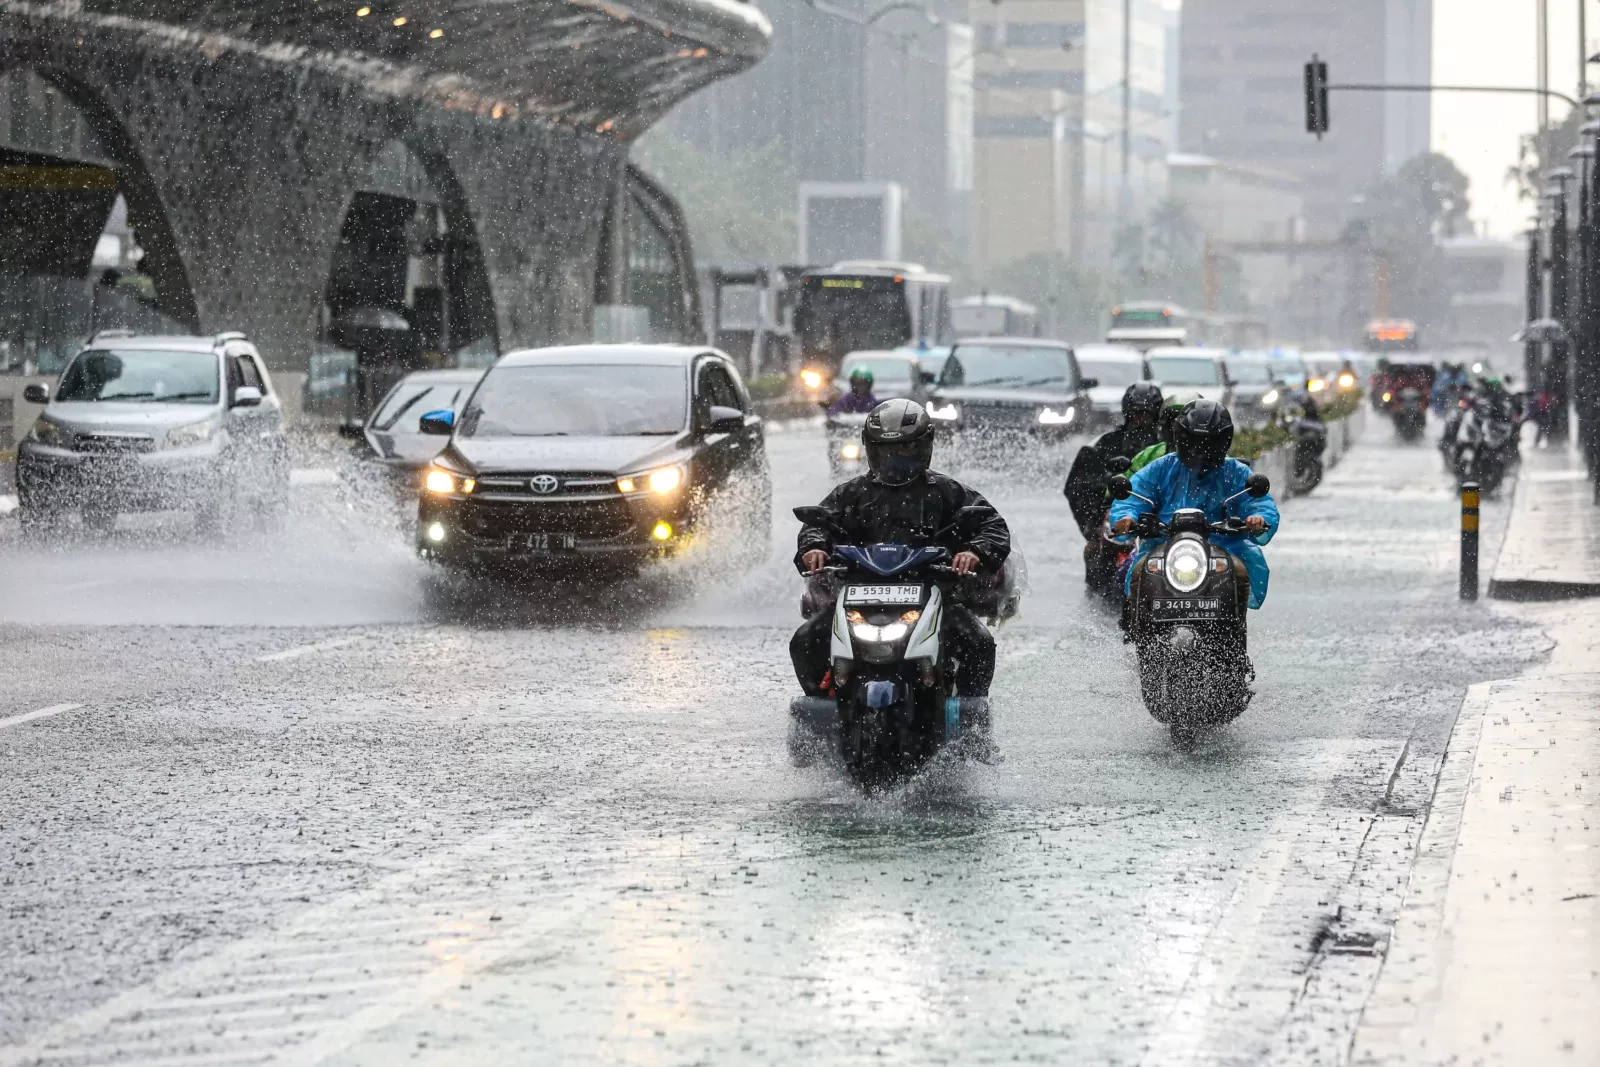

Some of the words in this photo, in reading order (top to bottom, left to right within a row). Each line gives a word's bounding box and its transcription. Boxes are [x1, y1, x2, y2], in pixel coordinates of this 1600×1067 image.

[849, 587, 857, 596] B
[863, 587, 891, 595] 5539
[897, 586, 918, 595] TMB
[1152, 600, 1161, 610] B
[1165, 600, 1191, 609] 3419
